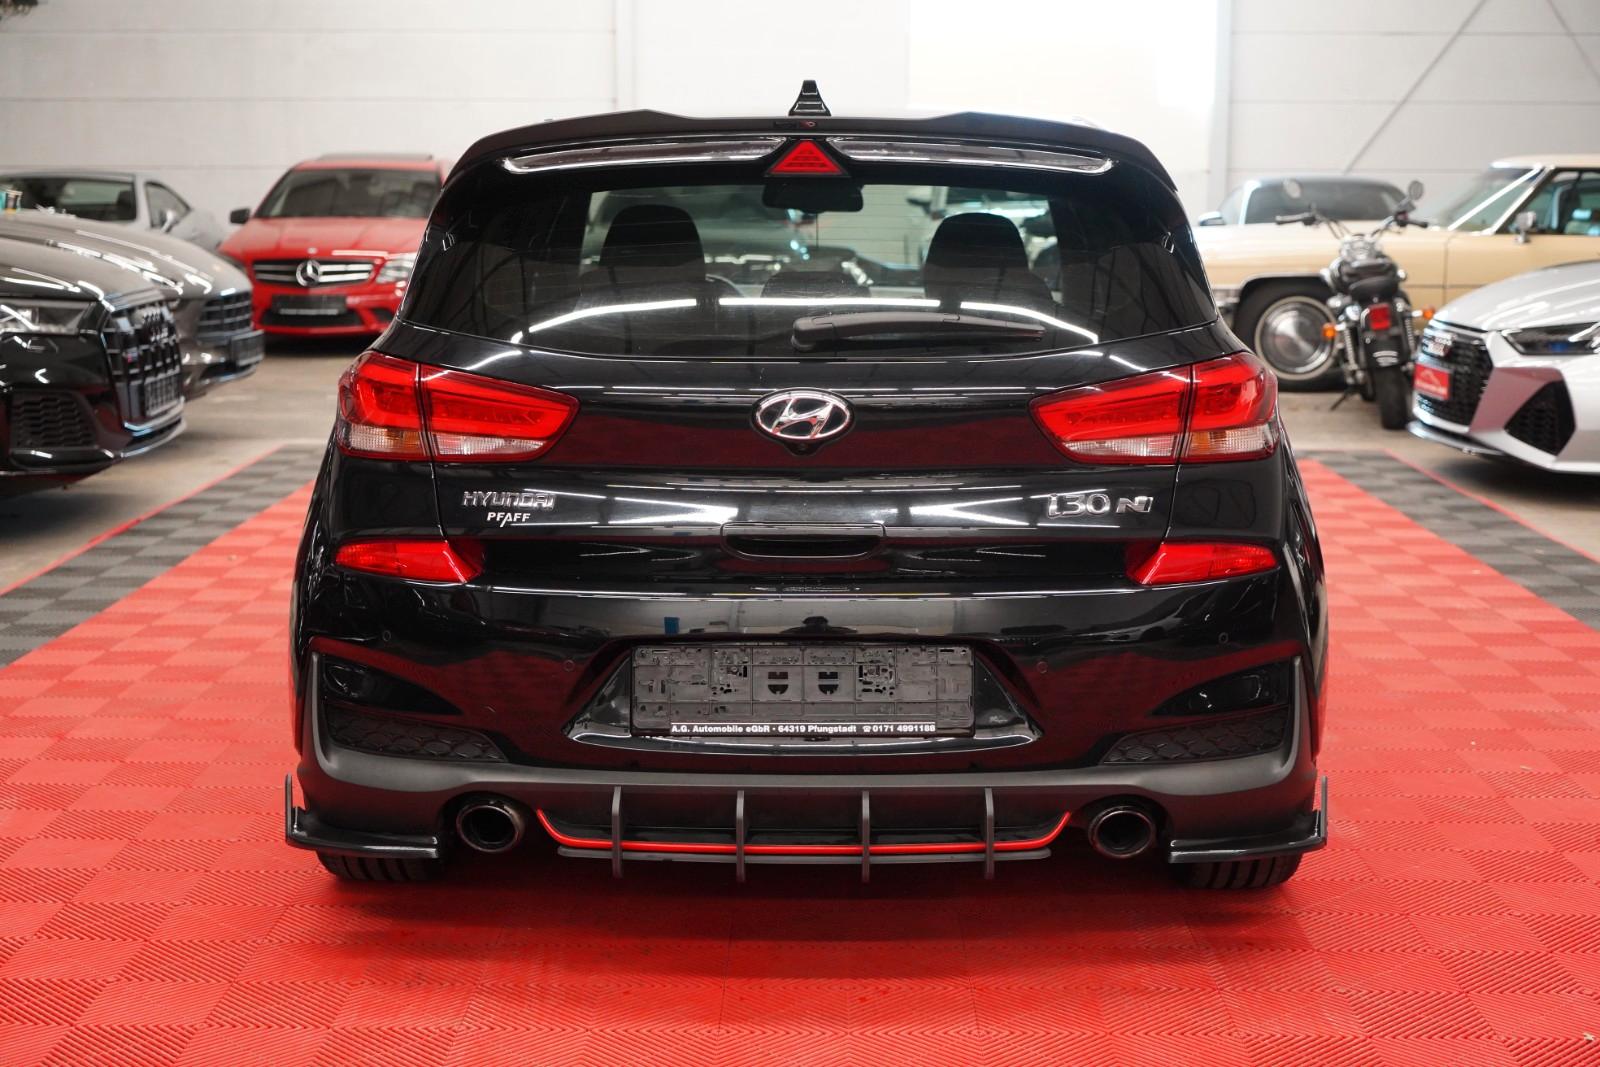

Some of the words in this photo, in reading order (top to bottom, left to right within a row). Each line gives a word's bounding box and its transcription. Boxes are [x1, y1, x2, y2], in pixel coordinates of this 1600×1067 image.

[462, 491, 556, 510] HYUNDAI
[1046, 494, 1110, 517] i30
[487, 512, 530, 527] PFAFF
[671, 725, 690, 733] A.G.
[693, 725, 744, 733] Automobile
[745, 725, 770, 733] eGbR
[778, 725, 805, 733] 64319
[807, 725, 857, 734] Pfungstadt
[872, 725, 894, 733] 0171
